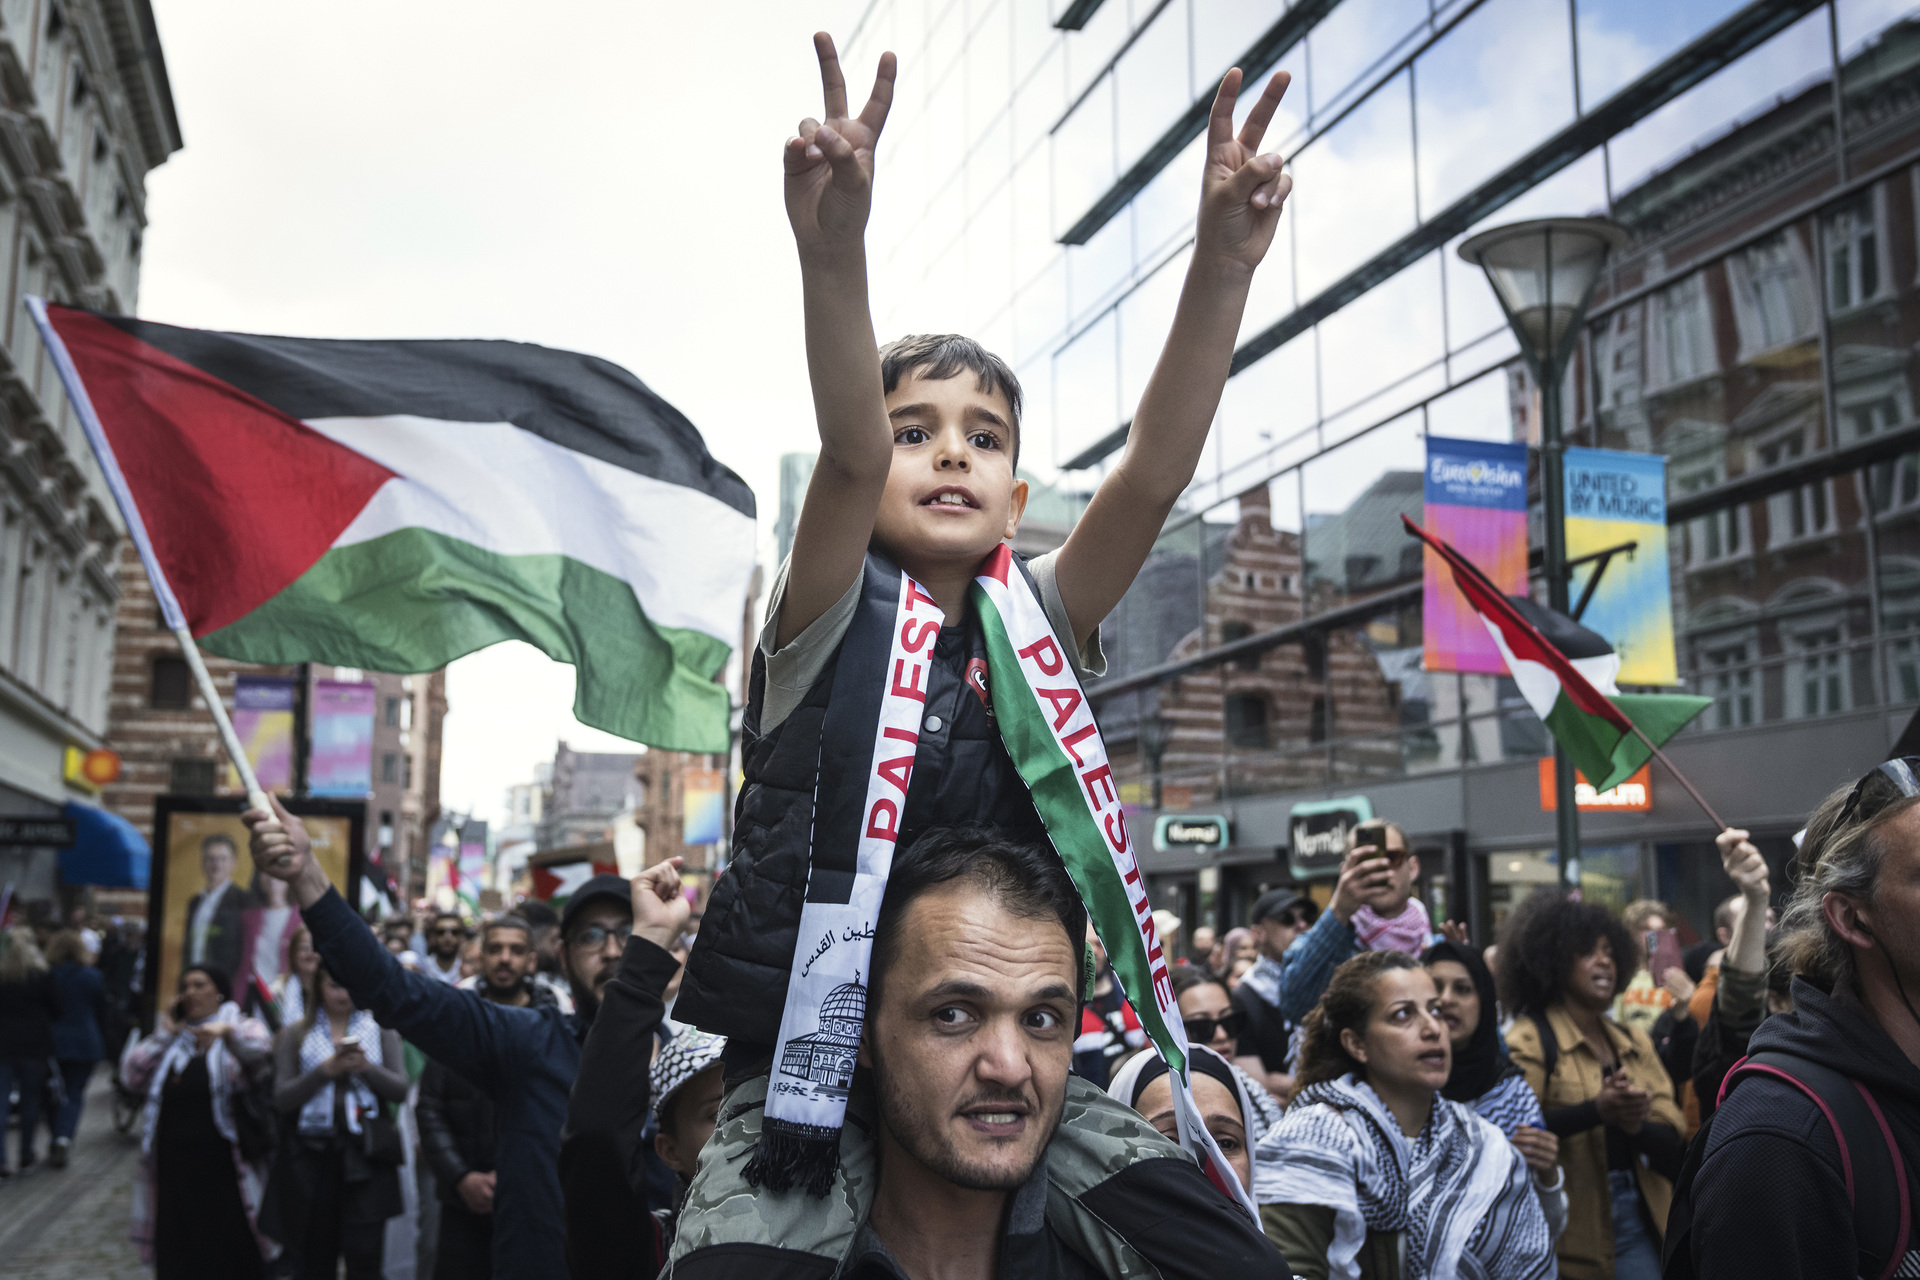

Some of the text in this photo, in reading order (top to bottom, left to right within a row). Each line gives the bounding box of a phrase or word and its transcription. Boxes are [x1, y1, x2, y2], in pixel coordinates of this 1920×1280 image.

[1569, 471, 1638, 494] UNITED
[1570, 492, 1661, 520] BY MUSIC
[1018, 634, 1176, 1013] PALESTINE
[1168, 819, 1218, 843] Normal
[1294, 819, 1347, 857] Normal
[801, 929, 836, 978] القدس
